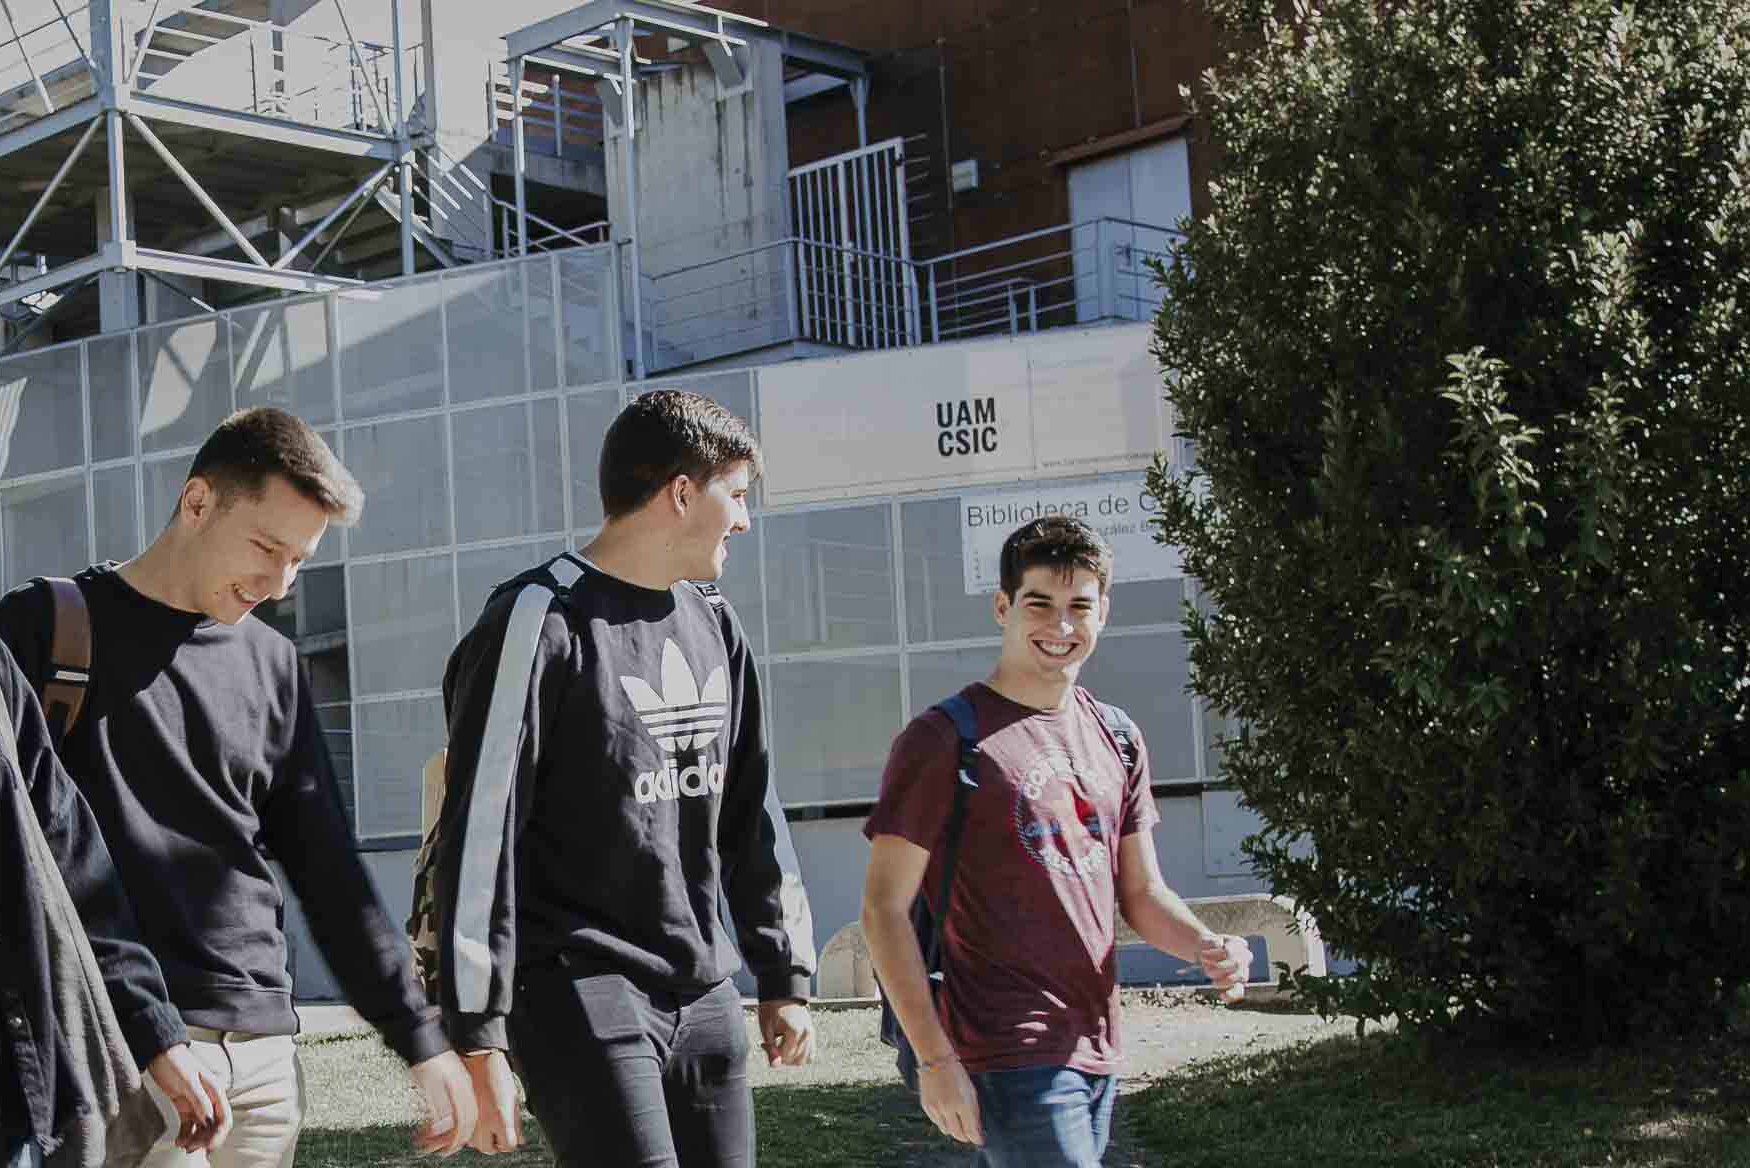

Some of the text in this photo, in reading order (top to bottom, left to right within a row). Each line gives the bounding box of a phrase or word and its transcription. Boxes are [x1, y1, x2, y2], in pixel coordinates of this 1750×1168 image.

[937, 397, 996, 428] UAM
[937, 426, 997, 457] CSIC
[967, 499, 1088, 527] Biblioteca
[1098, 493, 1129, 515] de
[634, 755, 725, 804] adida
